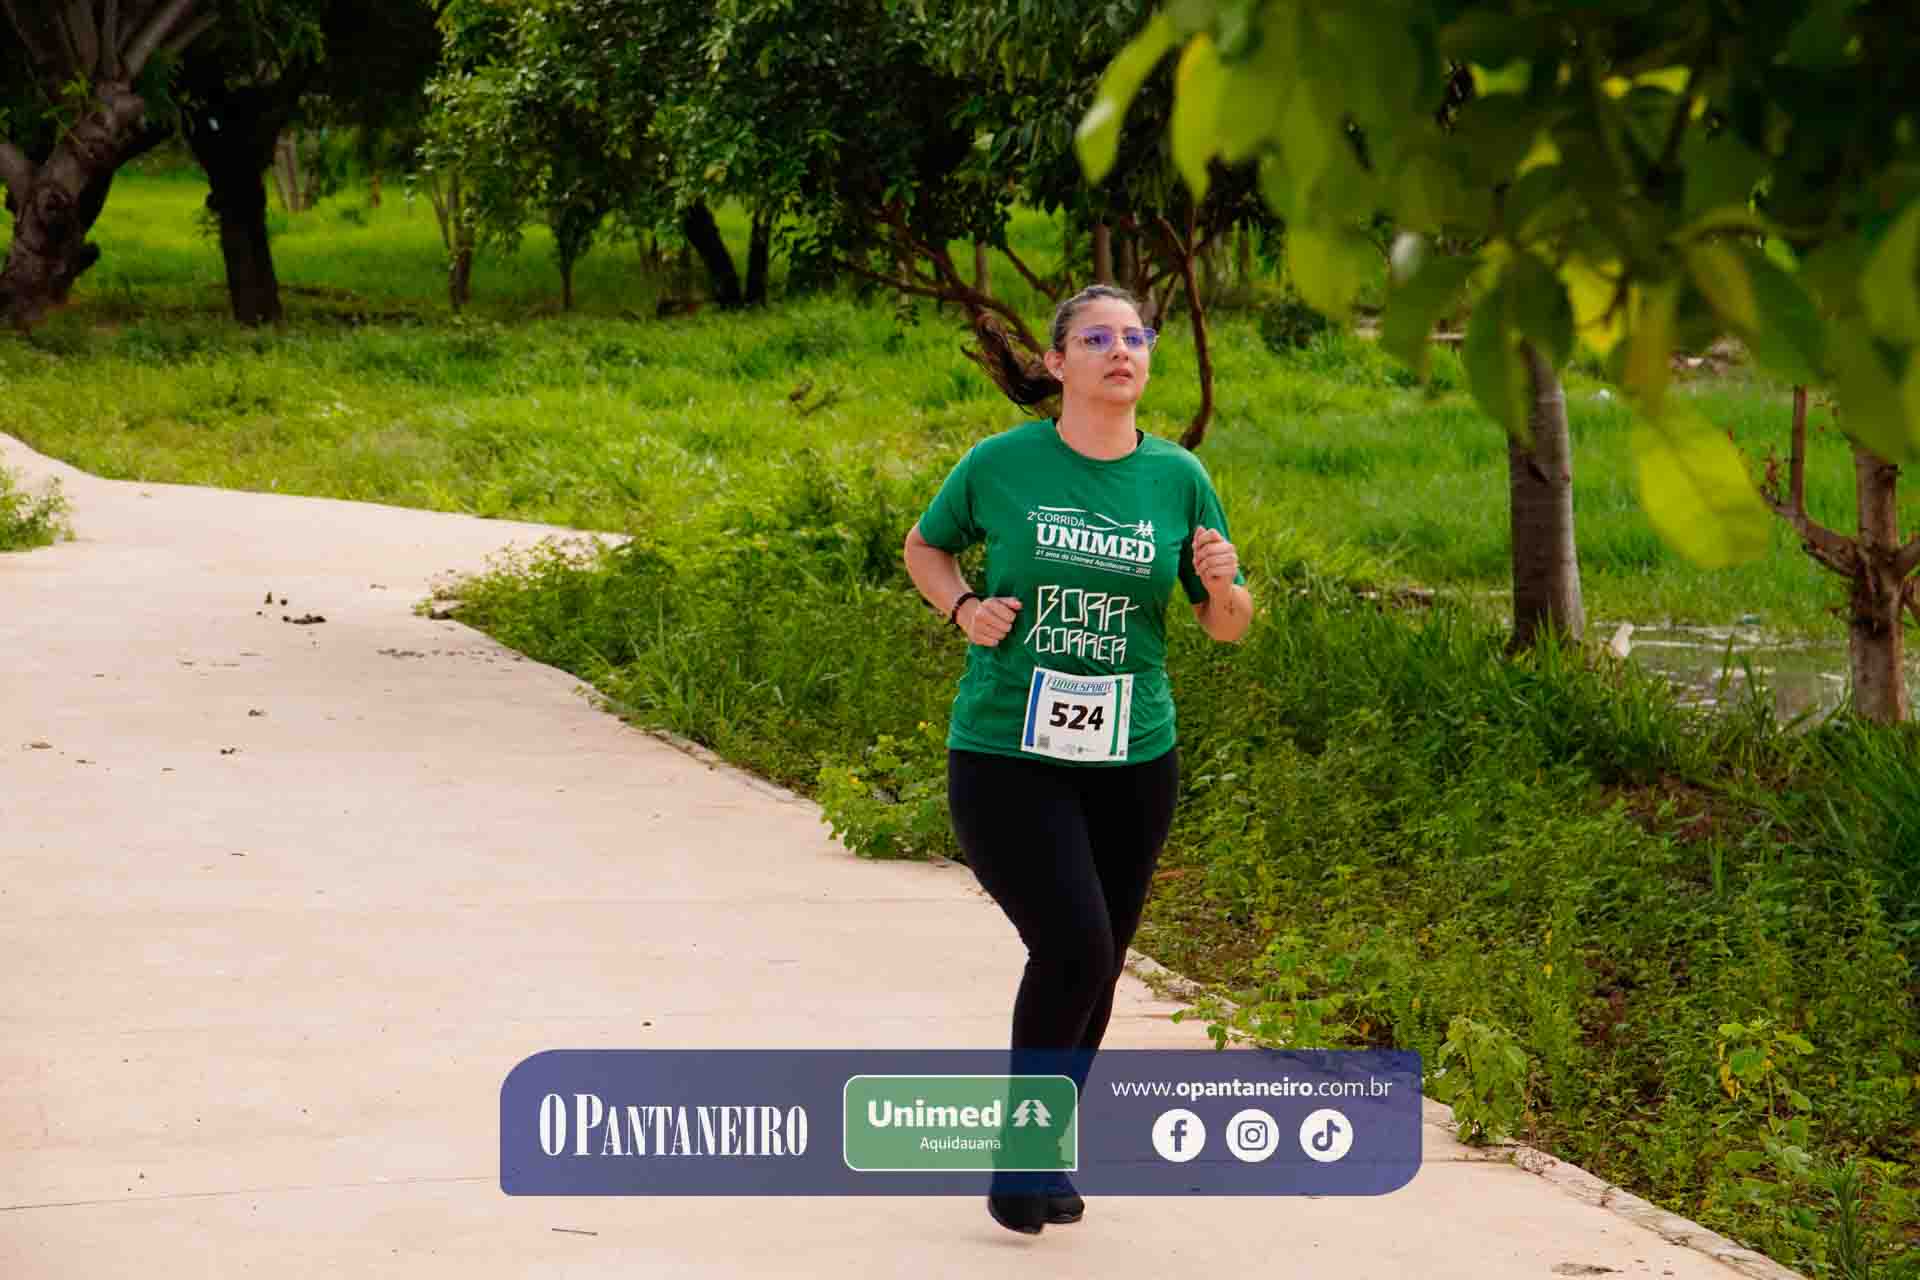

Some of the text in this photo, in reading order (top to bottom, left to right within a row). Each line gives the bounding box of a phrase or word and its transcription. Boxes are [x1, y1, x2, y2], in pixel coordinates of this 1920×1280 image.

[1037, 512, 1085, 528] CORRIDA
[1036, 523, 1156, 564] UNIMED
[1024, 585, 1140, 644] BORA
[1036, 626, 1127, 665] CORRER
[1049, 701, 1104, 731] 524
